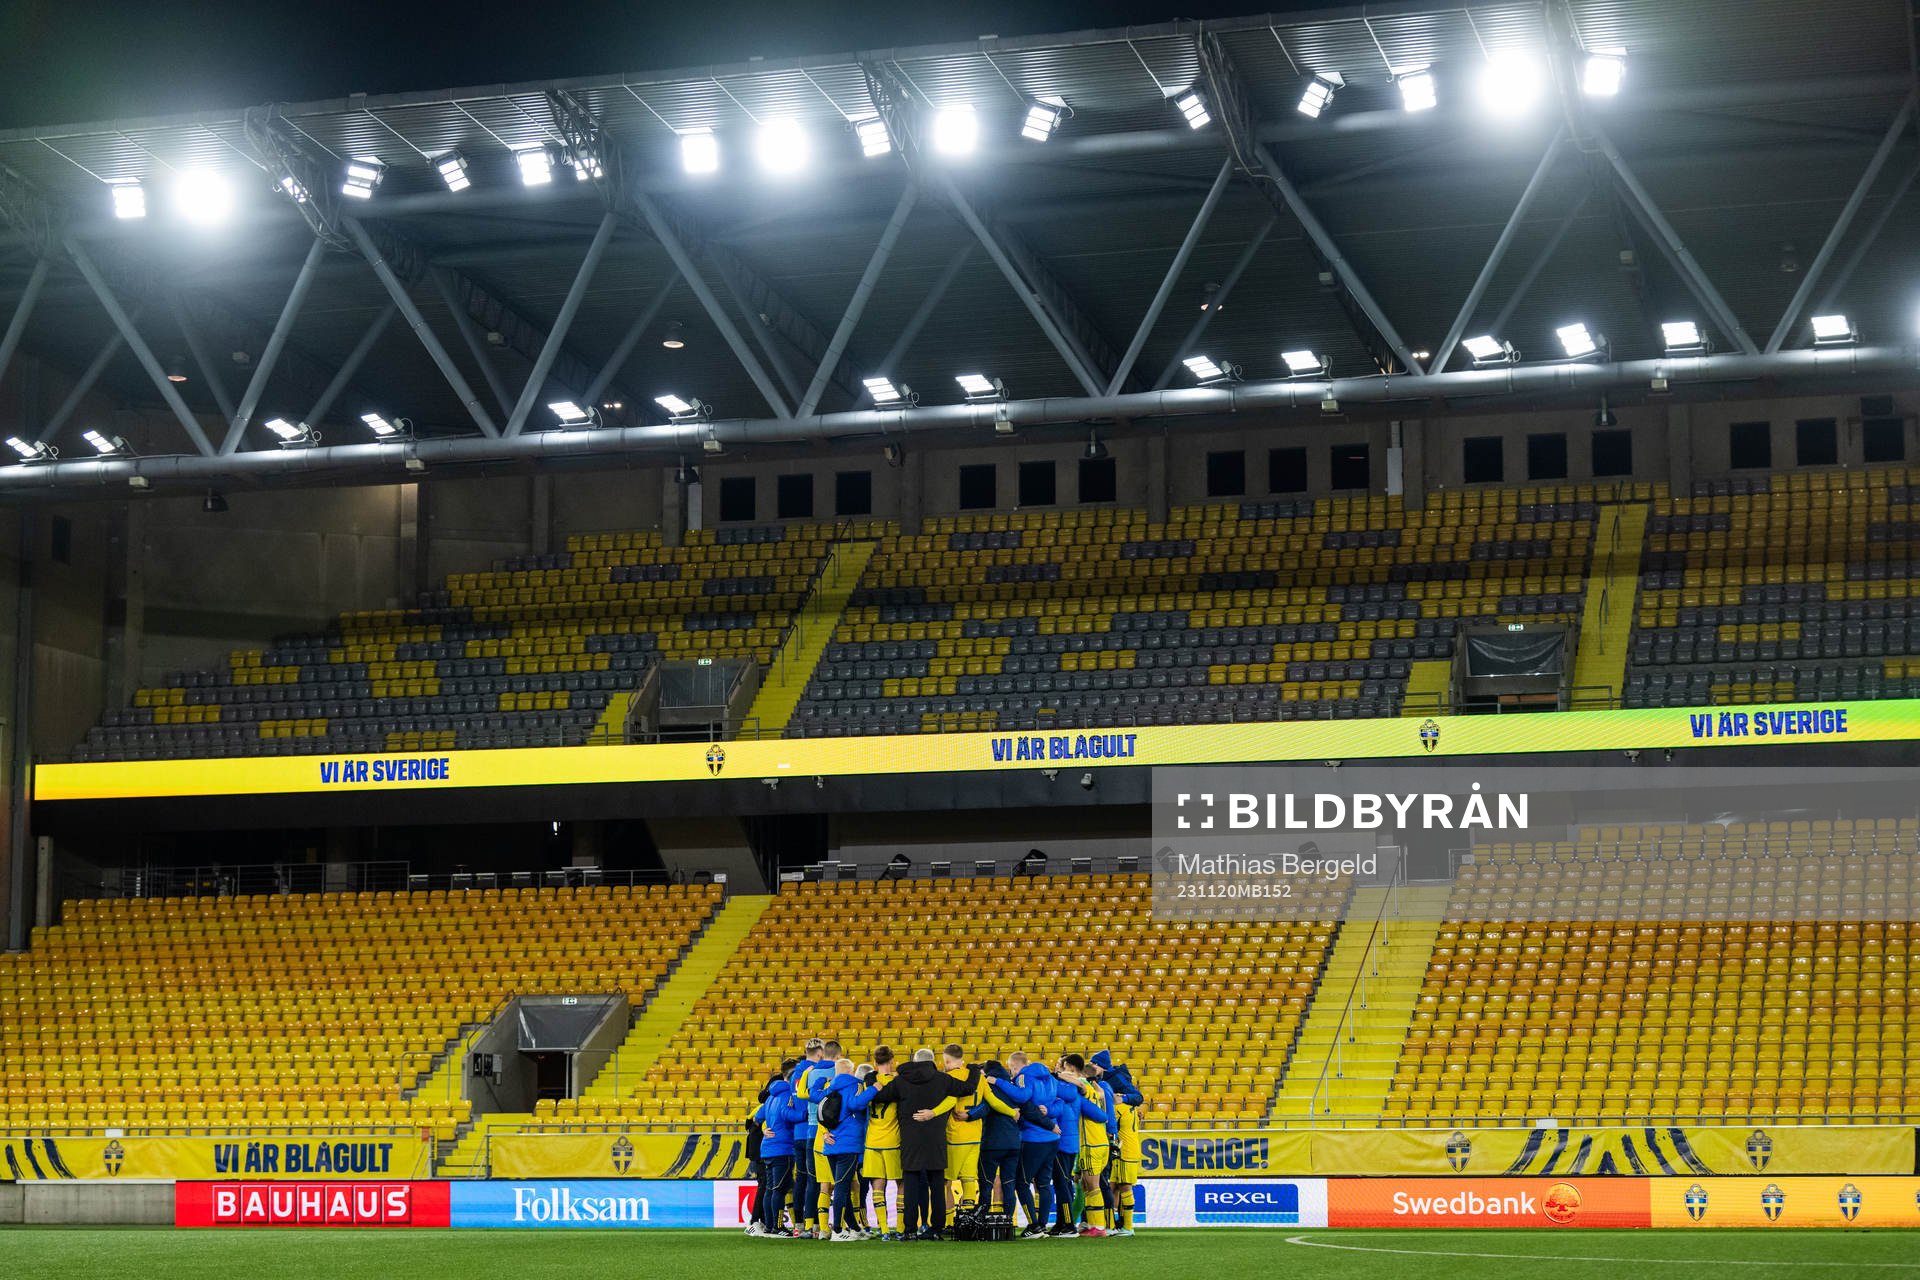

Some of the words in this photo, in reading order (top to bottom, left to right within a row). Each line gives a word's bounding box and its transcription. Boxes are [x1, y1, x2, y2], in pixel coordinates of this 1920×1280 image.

[1690, 714, 1712, 738] VI
[1718, 711, 1749, 737] ÄR
[1753, 709, 1848, 736] SVERIGE
[991, 738, 1012, 762] VI
[1016, 735, 1045, 761] ÄR
[1049, 734, 1137, 760] BLÅGULT
[320, 761, 339, 783] VI
[342, 760, 368, 783] ÄR
[372, 758, 449, 782] SVERIGE
[214, 1144, 239, 1173] VI
[244, 1142, 279, 1173] ÄR
[285, 1141, 393, 1173] BLÅGULT
[1141, 1137, 1269, 1170] SVERIGE!
[217, 1191, 407, 1217] BAUHAUS
[512, 1187, 650, 1221] Folksam
[1393, 1191, 1537, 1215] Swedbank
